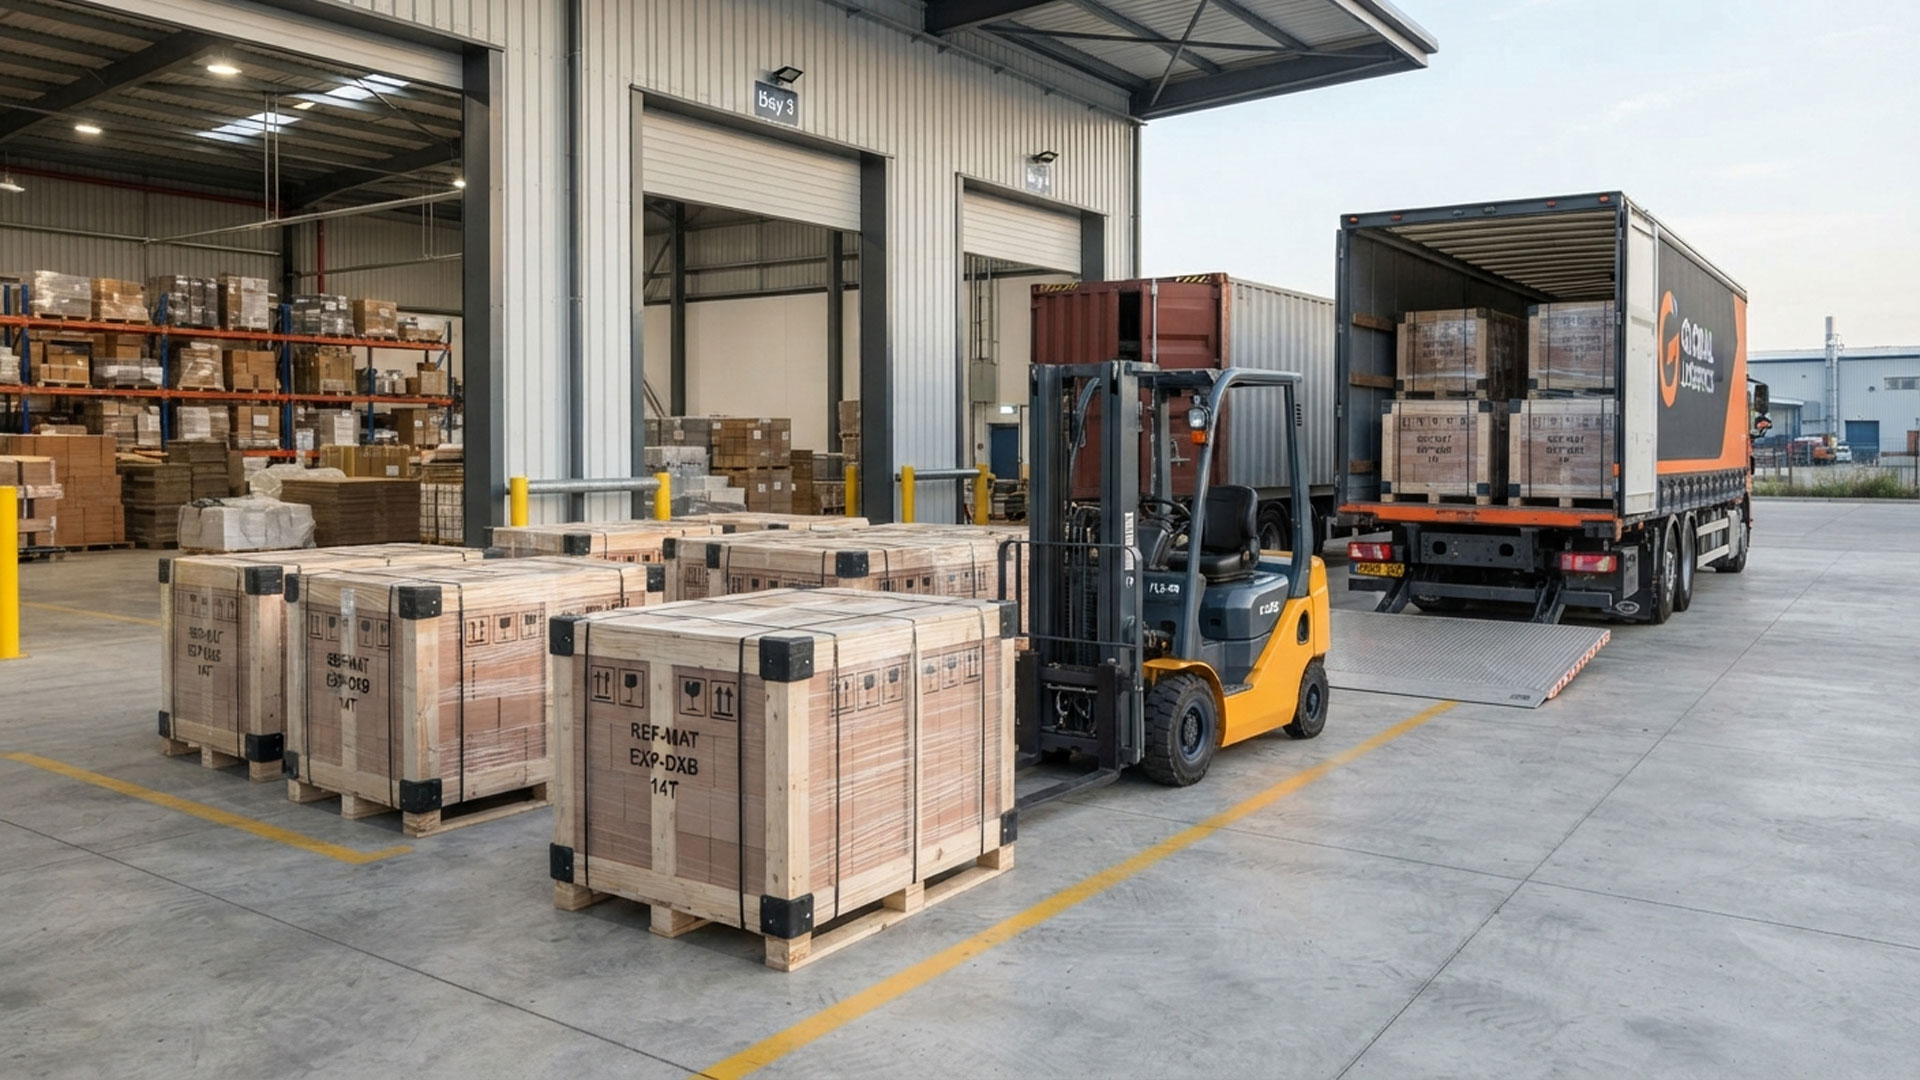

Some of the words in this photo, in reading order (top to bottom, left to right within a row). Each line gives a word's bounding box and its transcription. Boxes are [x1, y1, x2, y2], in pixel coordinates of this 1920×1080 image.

[630, 722, 699, 749] REF-MAT
[630, 748, 699, 776] EXP-DXB
[650, 778, 679, 799] 14T
